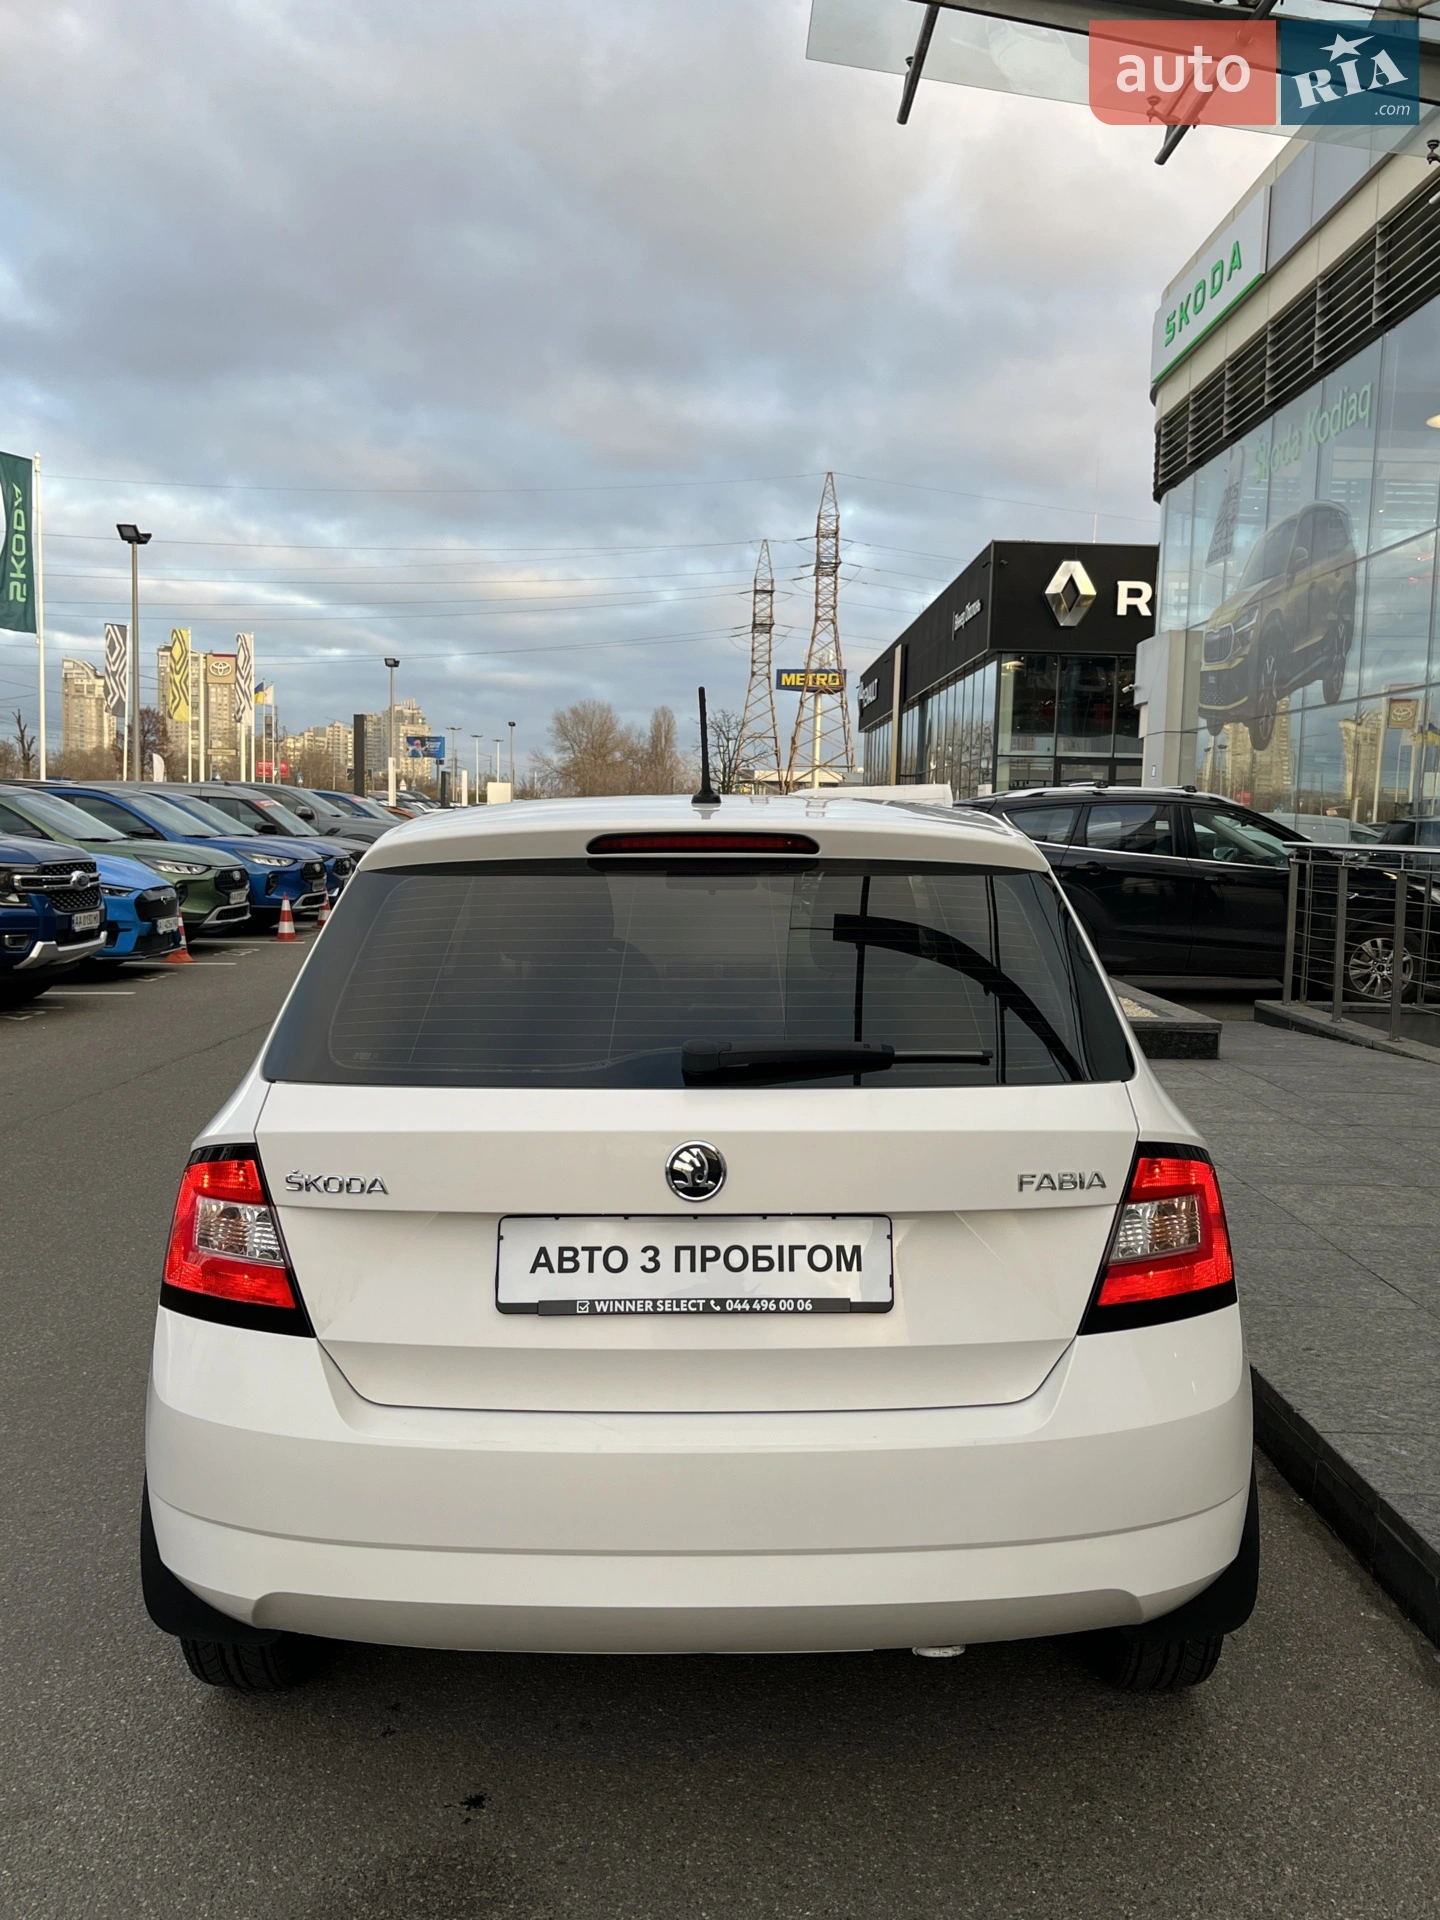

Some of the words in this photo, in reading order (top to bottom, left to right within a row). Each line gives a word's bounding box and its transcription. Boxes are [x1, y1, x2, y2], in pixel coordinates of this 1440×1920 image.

[1303, 382, 1372, 451] Kodiaq
[781, 673, 840, 686] METRO
[285, 1169, 389, 1195] ŠKODA
[1017, 1170, 1107, 1192] FABIA
[529, 1245, 629, 1274] АВТО
[674, 1244, 863, 1273] ПРОБІГОМ
[594, 1300, 654, 1312] WINNER
[656, 1300, 706, 1312] SELECT
[725, 1299, 750, 1311] 044
[752, 1299, 777, 1311] 496
[778, 1299, 795, 1311] 00
[796, 1299, 813, 1311] 06
